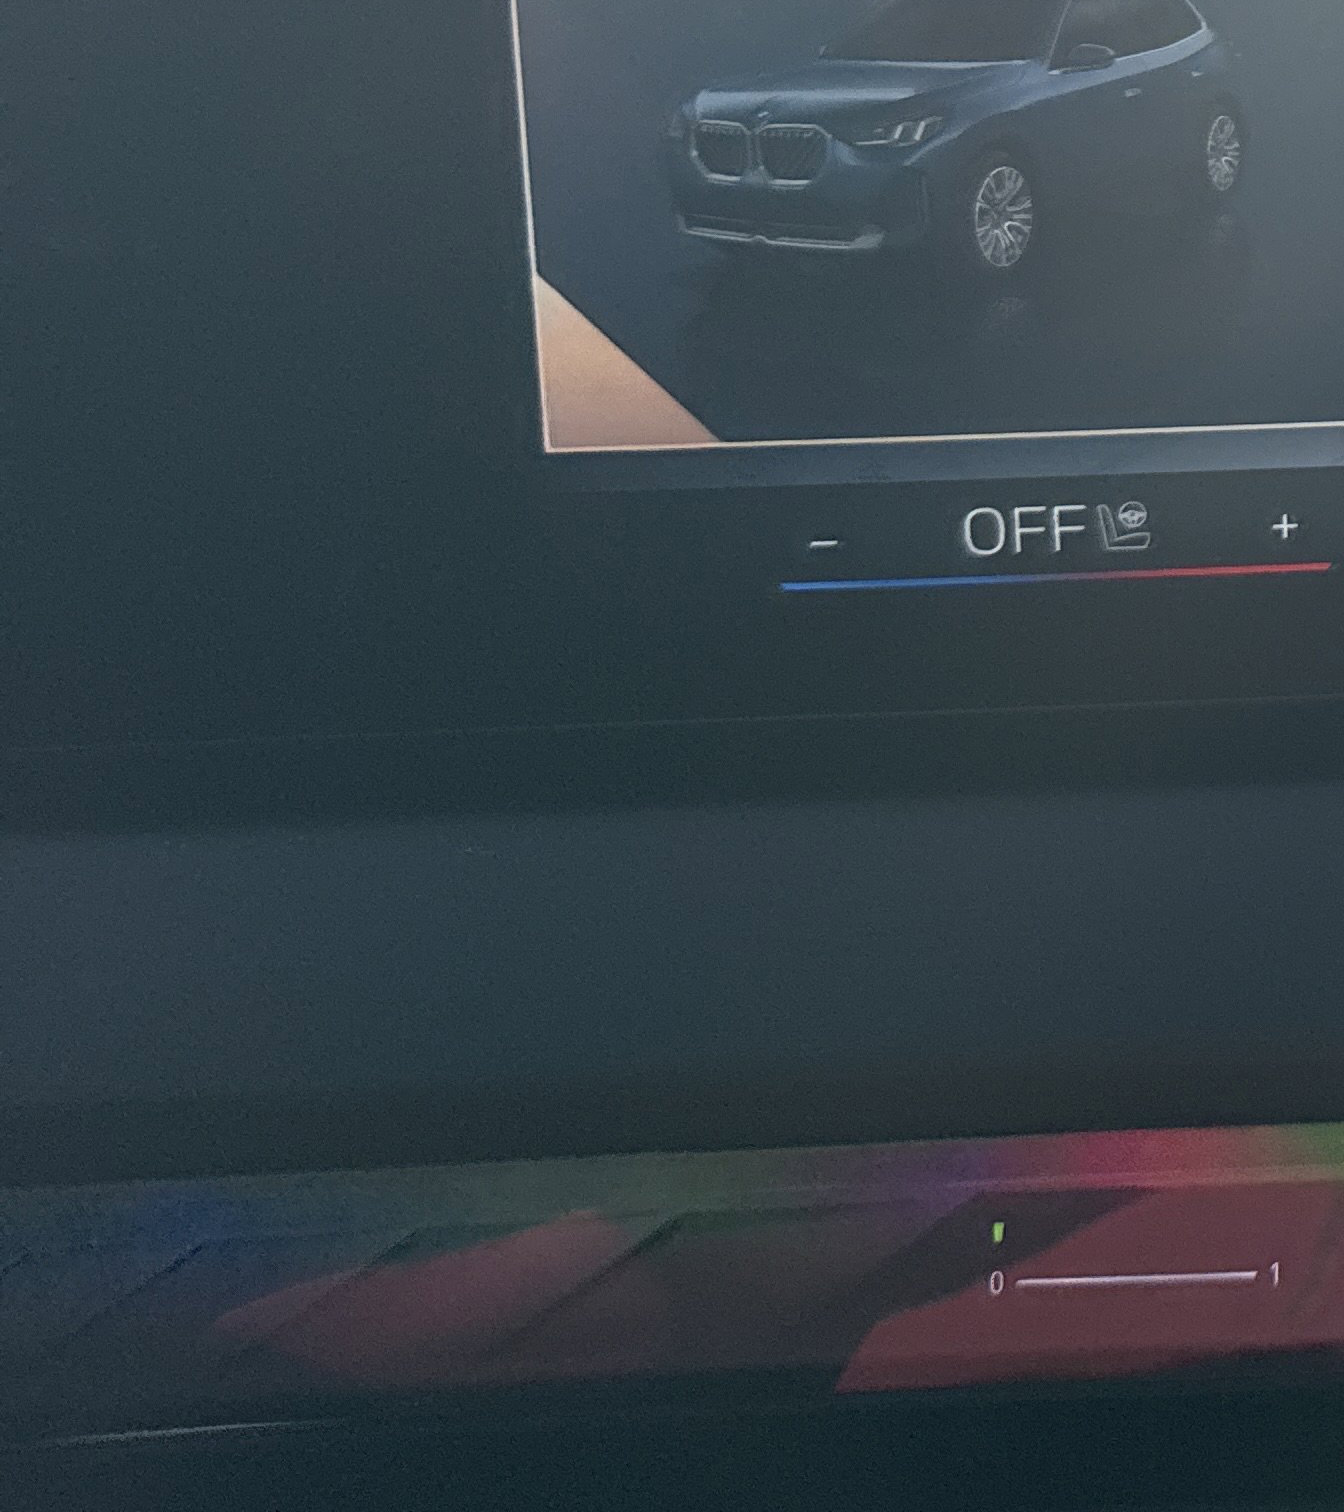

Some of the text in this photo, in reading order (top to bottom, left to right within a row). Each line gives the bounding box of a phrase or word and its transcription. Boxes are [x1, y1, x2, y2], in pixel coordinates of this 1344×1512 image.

[962, 504, 1087, 557] OFF
[988, 1262, 1281, 1295] 0 1
